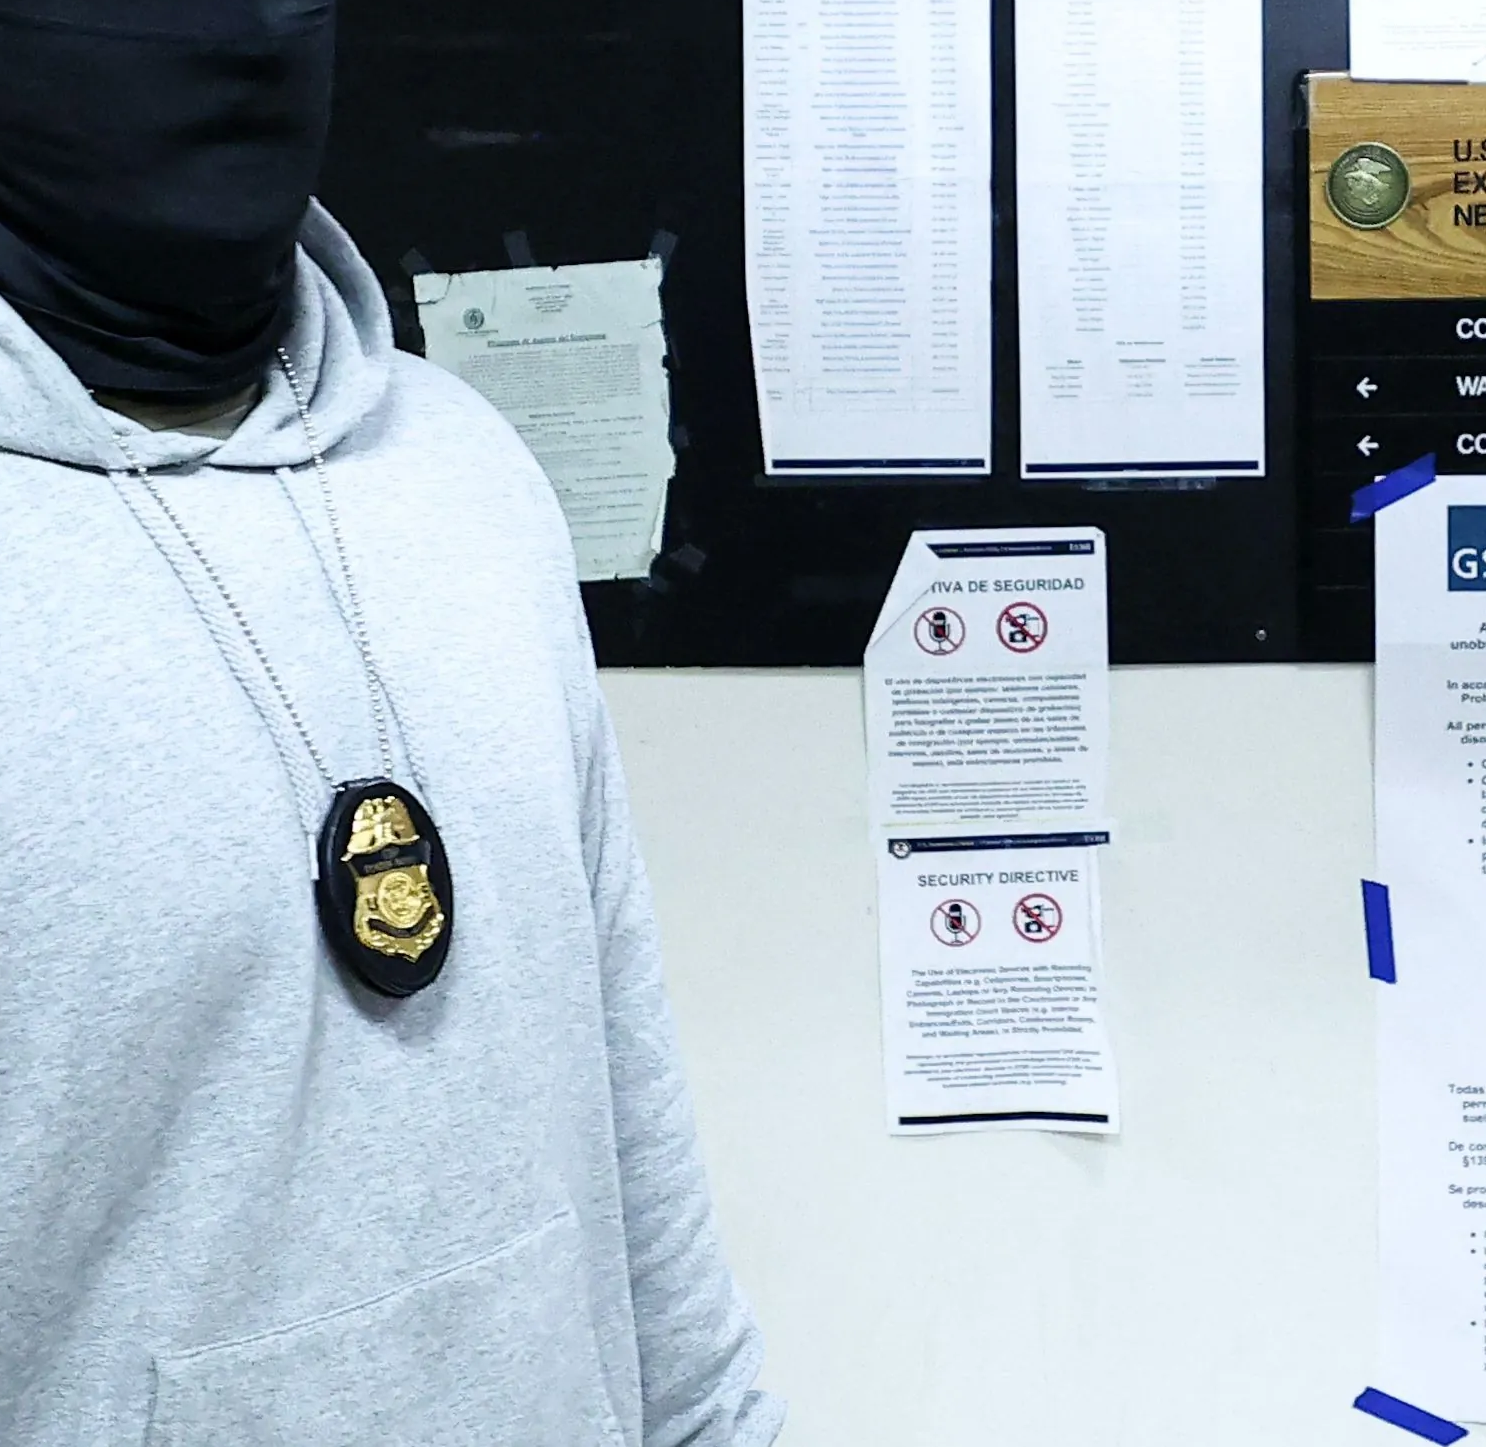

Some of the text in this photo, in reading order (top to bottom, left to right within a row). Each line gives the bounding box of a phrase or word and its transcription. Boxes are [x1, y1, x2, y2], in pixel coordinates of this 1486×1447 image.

[968, 581, 987, 592] DE
[994, 578, 1084, 592] SEGURIDAD
[918, 870, 1078, 887] SECURITY DIRECTIVE
